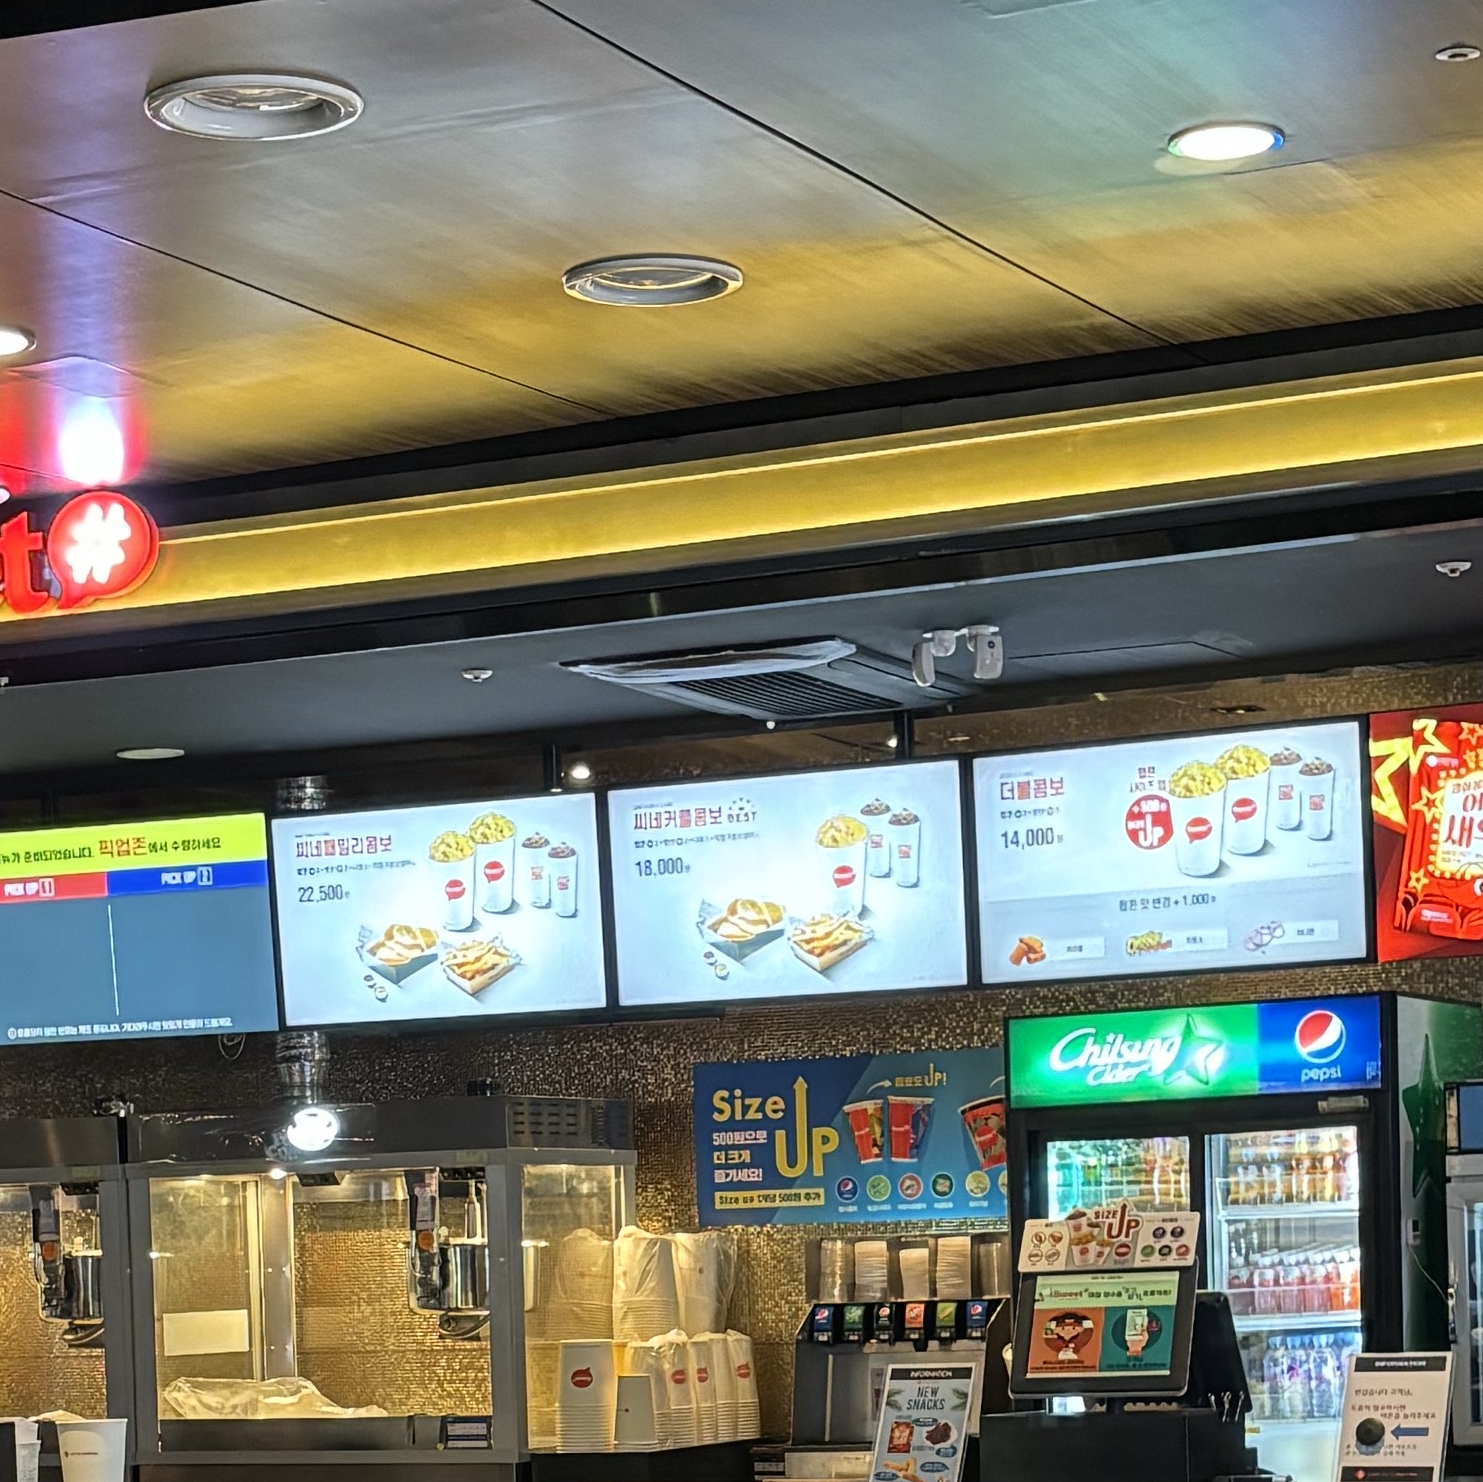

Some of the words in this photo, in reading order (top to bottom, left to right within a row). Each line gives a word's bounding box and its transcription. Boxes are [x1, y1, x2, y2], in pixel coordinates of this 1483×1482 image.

[1048, 1026, 1181, 1078] Chilsung
[1301, 1064, 1342, 1083] pepsi
[712, 1089, 786, 1123] Size
[774, 1075, 840, 1178] UP
[1093, 1210, 1118, 1220] SIZE
[1106, 1203, 1140, 1240] UP
[906, 1398, 946, 1410] SNACKS
[917, 1386, 939, 1398] NEW
